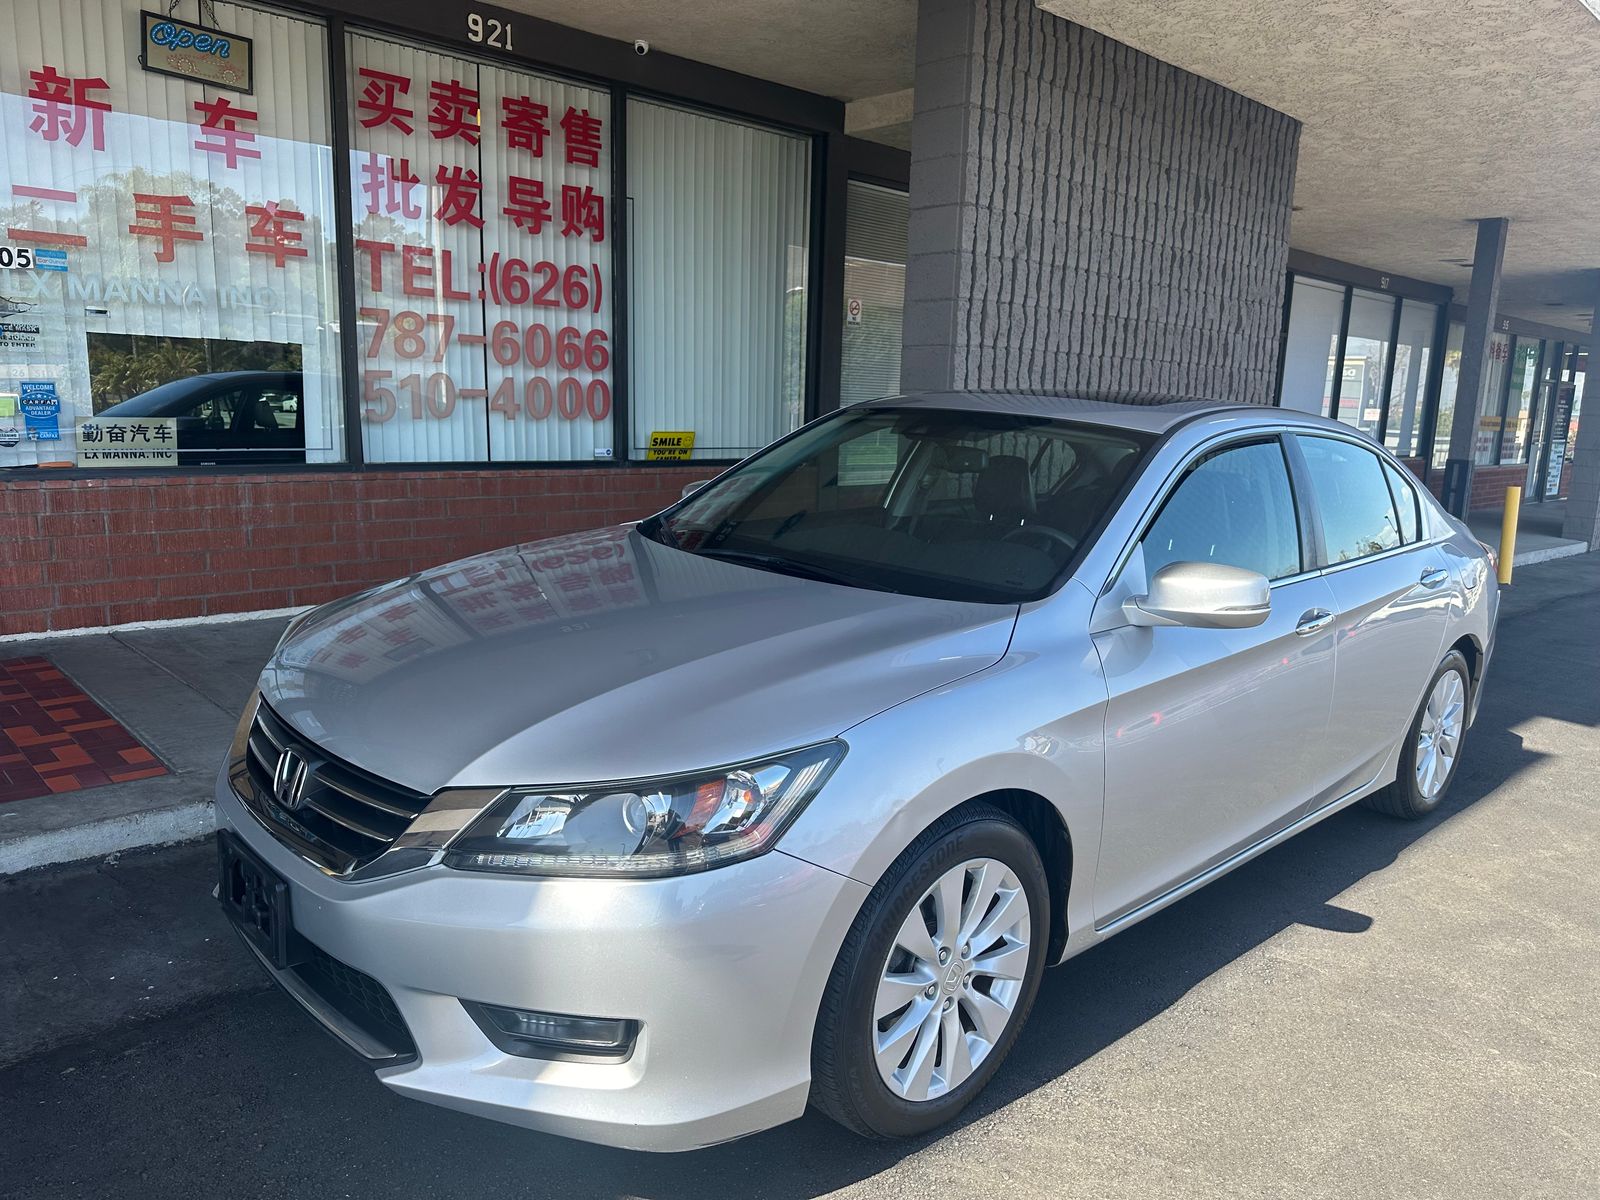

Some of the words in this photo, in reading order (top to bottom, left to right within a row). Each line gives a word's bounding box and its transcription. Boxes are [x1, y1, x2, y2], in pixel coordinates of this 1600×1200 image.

[150, 21, 230, 59] Open
[467, 13, 513, 51] 921
[357, 67, 603, 168] 买卖寄售
[361, 153, 605, 243] 批发导购
[7, 184, 308, 268] 二手车
[67, 271, 203, 306] MANNA
[359, 307, 610, 372] 787-6066
[363, 370, 611, 423] 510-4000
[81, 424, 173, 443] 勤奋汽车
[651, 437, 682, 446] SMILE
[84, 448, 98, 459] LX
[152, 448, 172, 459] INC
